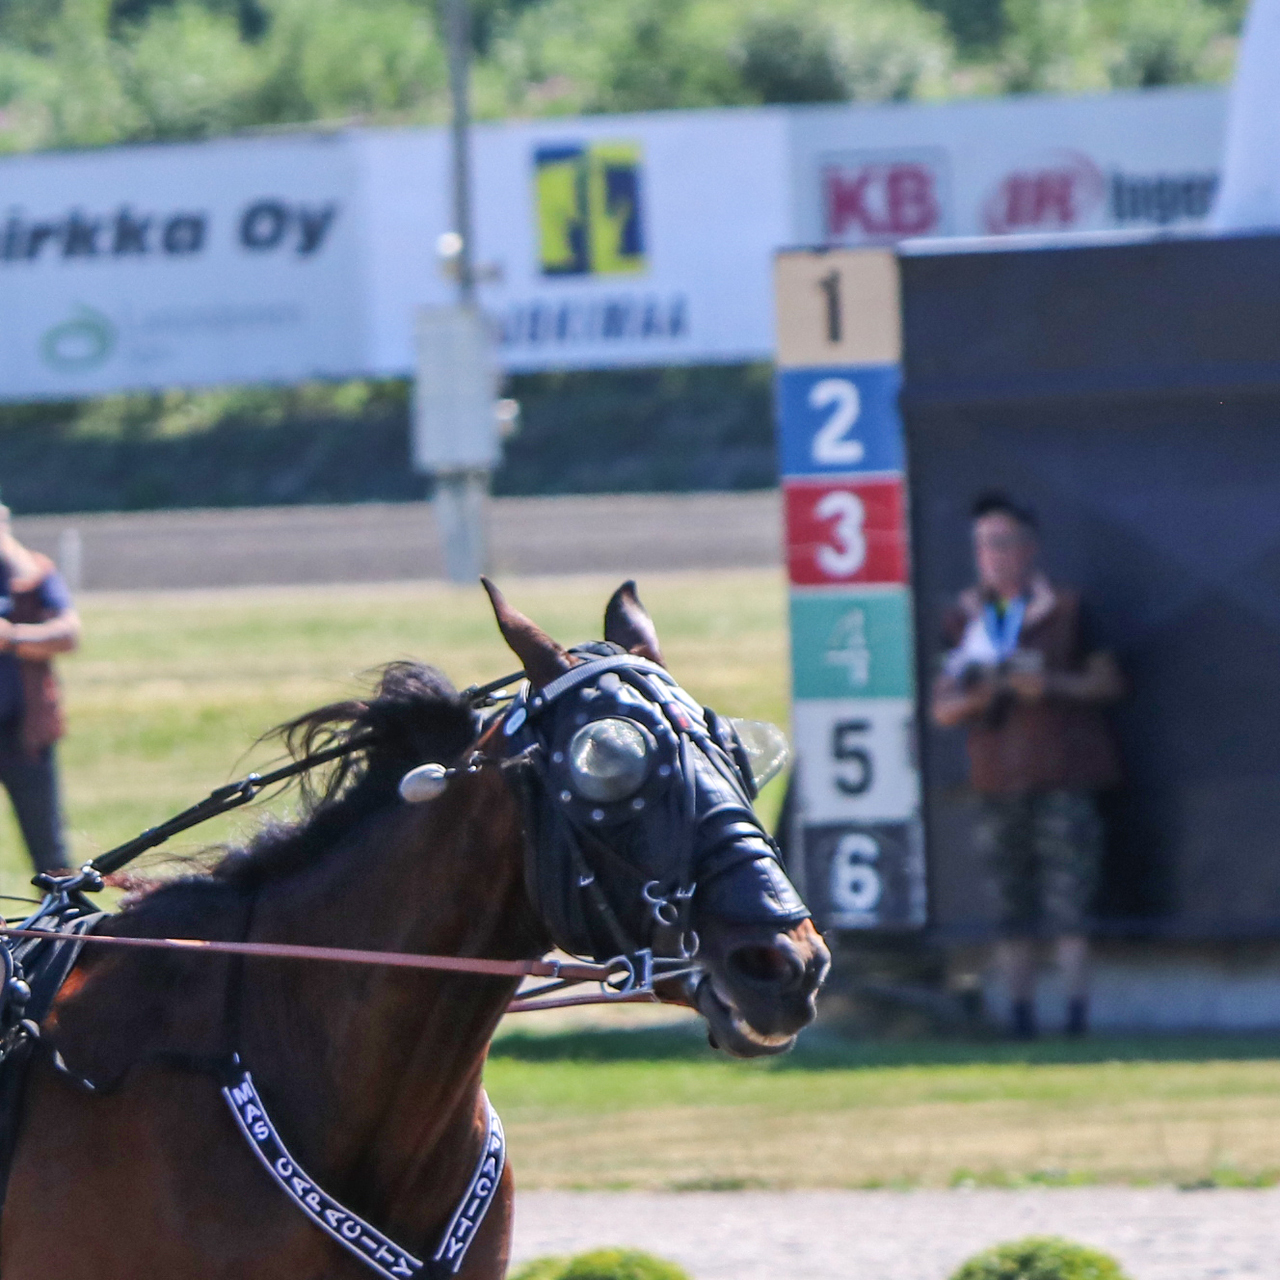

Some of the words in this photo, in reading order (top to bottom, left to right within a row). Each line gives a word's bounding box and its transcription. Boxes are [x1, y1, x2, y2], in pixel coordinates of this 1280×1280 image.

[241, 198, 336, 258] Oy
[826, 162, 938, 235] KB
[819, 268, 843, 344] 1
[808, 379, 866, 465] 2
[813, 490, 867, 578] 3
[825, 607, 870, 688] 4
[831, 718, 875, 798] 5
[829, 832, 881, 912] 6
[274, 1156, 414, 1277] CAPACITY
